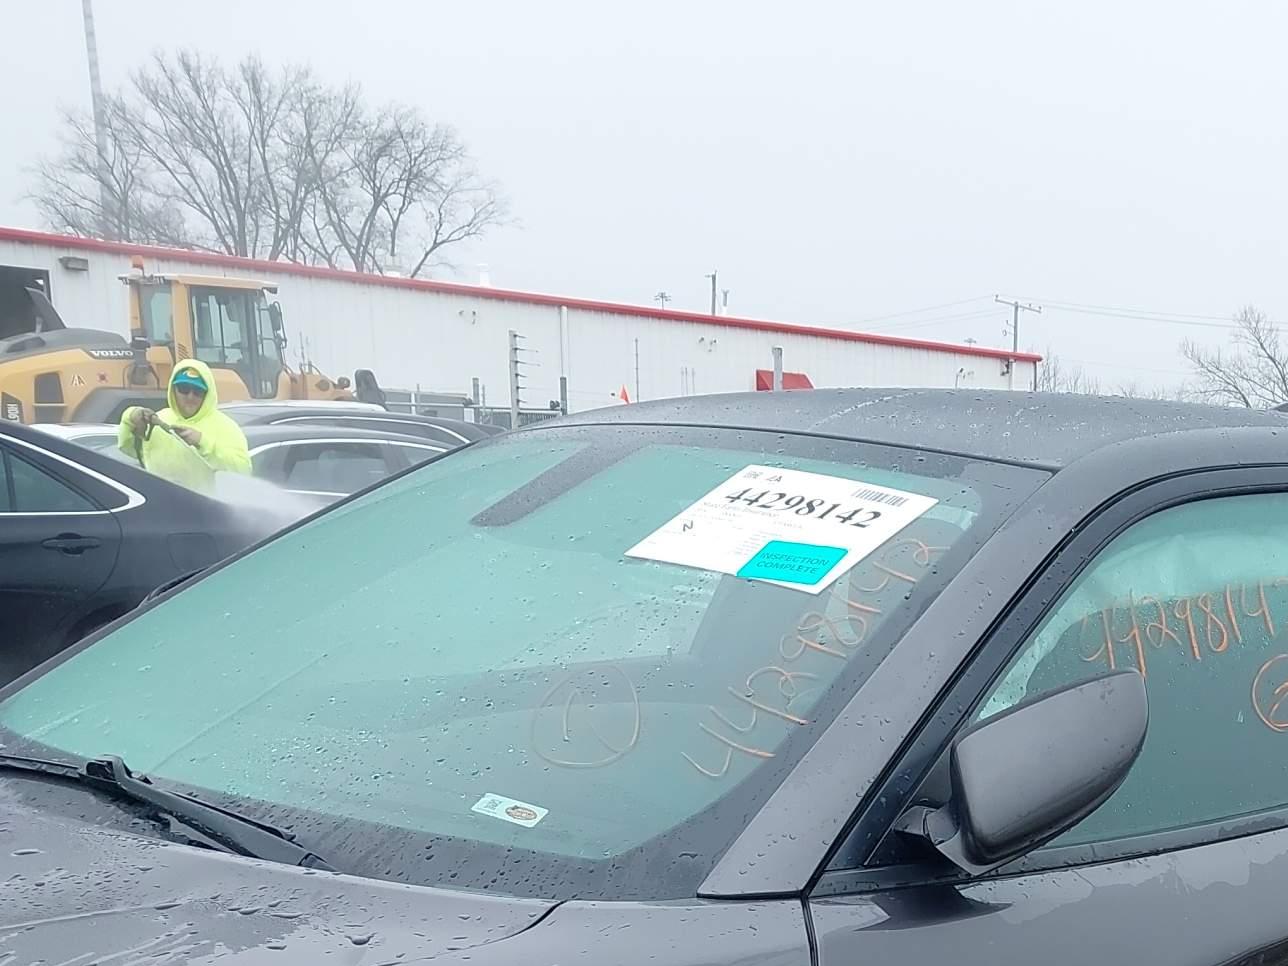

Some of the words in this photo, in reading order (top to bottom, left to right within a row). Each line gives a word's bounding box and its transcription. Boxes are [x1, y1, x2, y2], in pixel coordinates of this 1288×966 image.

[725, 487, 882, 529] 44298142
[761, 552, 830, 567] INSPECTION
[756, 560, 819, 575] COMPLETE
